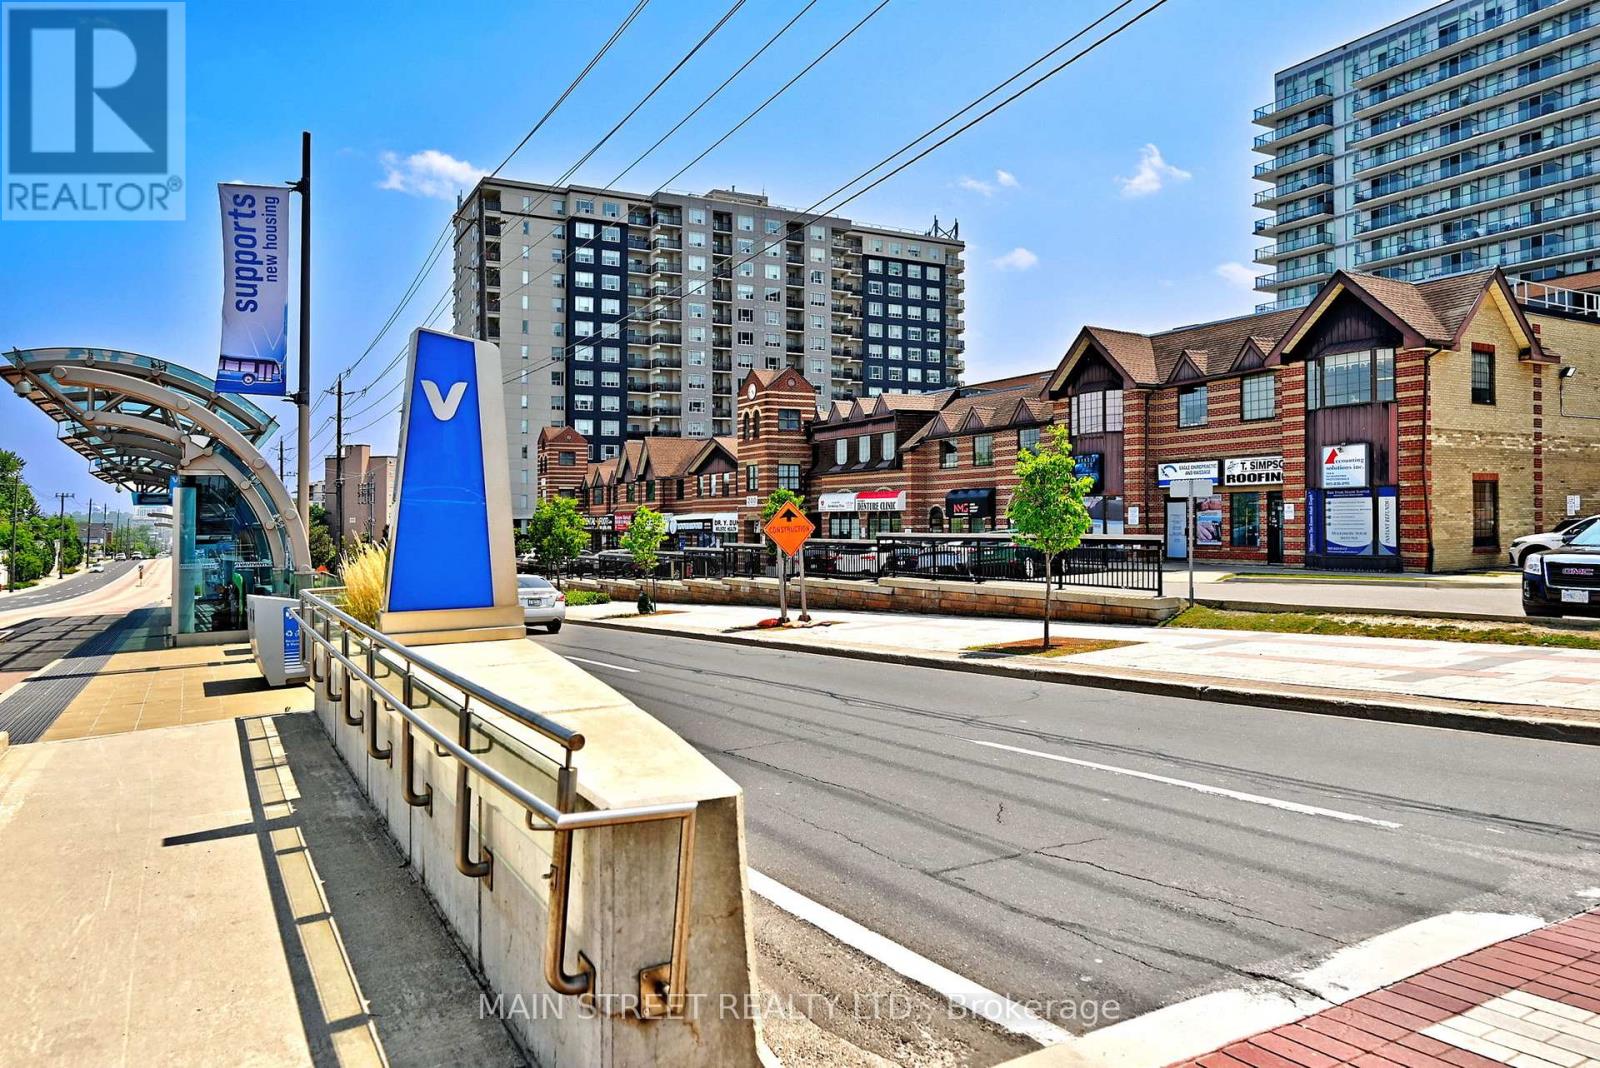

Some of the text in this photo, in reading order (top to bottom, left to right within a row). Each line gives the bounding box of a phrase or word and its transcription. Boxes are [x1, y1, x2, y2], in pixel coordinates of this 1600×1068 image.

[262, 196, 280, 282] new housing
[228, 194, 263, 313] supports
[1240, 461, 1247, 470] T.
[1226, 472, 1284, 483] ROOFIN
[880, 501, 896, 510] CLINIC
[769, 525, 809, 534] CONSTRUCTION
[1562, 568, 1594, 576] GMC
